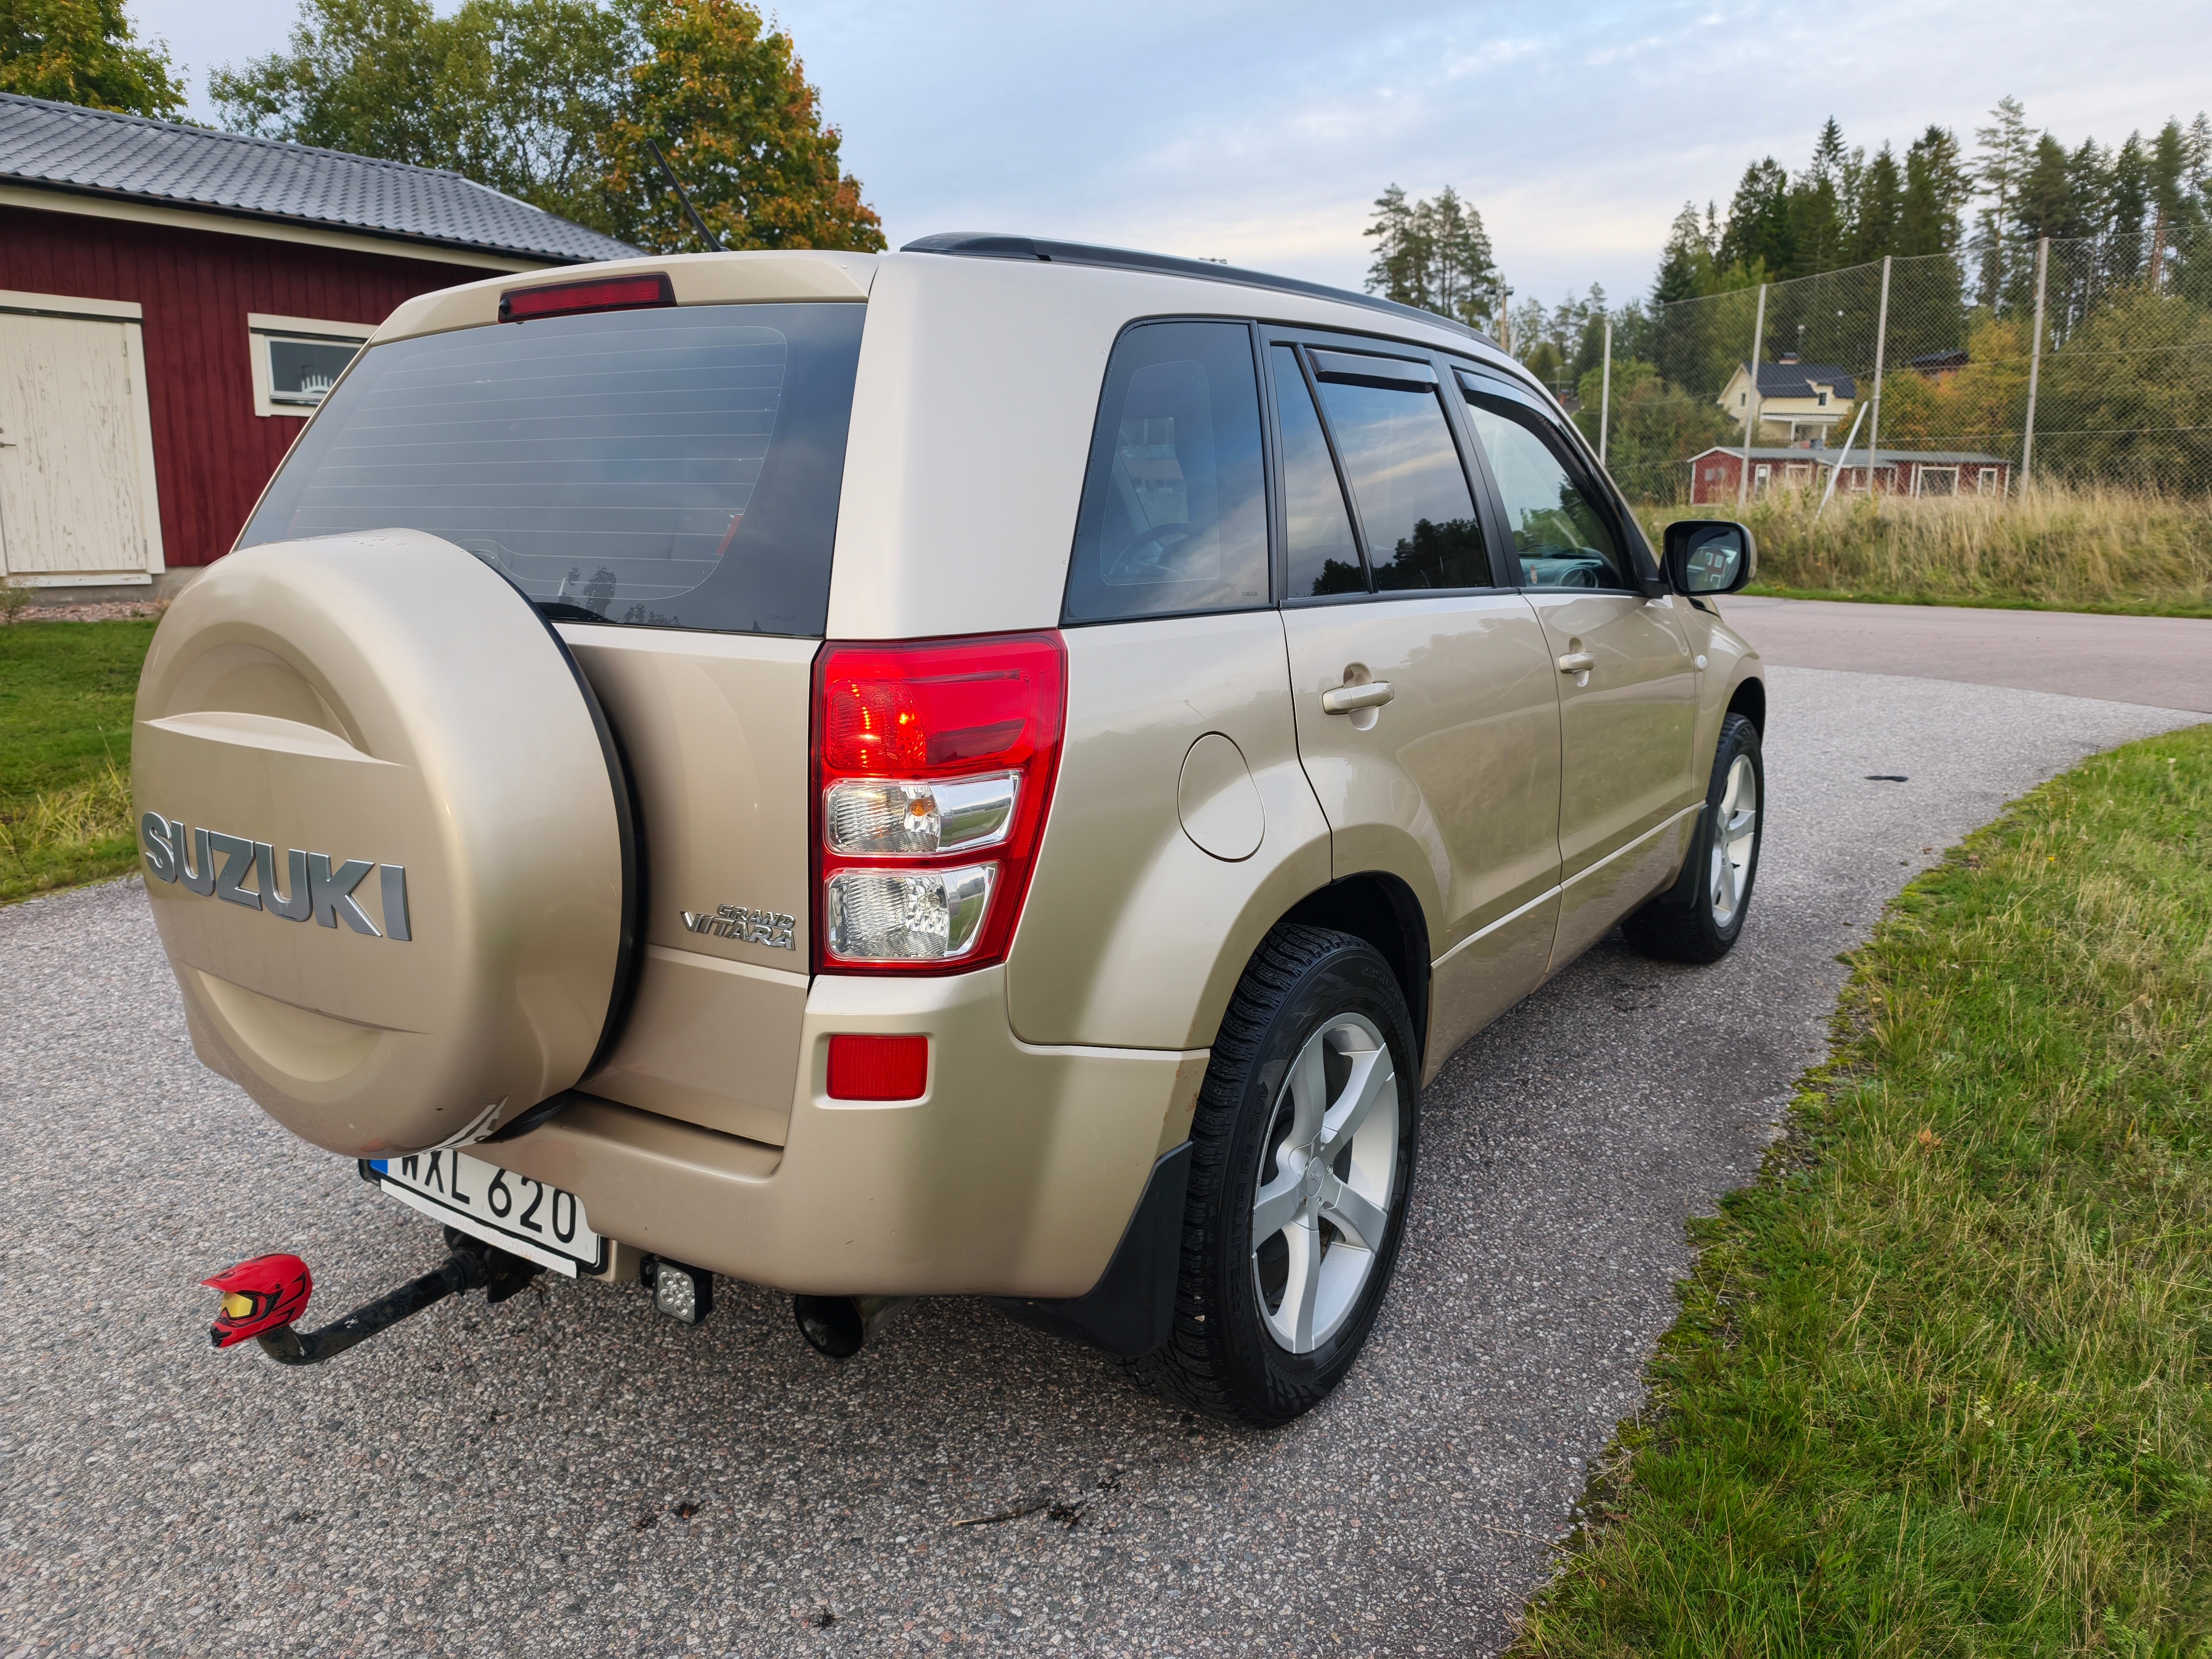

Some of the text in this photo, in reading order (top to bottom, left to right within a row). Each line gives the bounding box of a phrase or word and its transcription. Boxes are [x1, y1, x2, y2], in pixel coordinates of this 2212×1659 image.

[141, 811, 412, 941] SUZUKI
[679, 911, 795, 950] VITARA
[717, 903, 795, 929] GRAND
[1249, 1081, 1269, 1136] SUV
[488, 1168, 576, 1244] 620
[484, 1229, 503, 1244] LUND
[510, 1240, 561, 1268] TRELLEBORG
